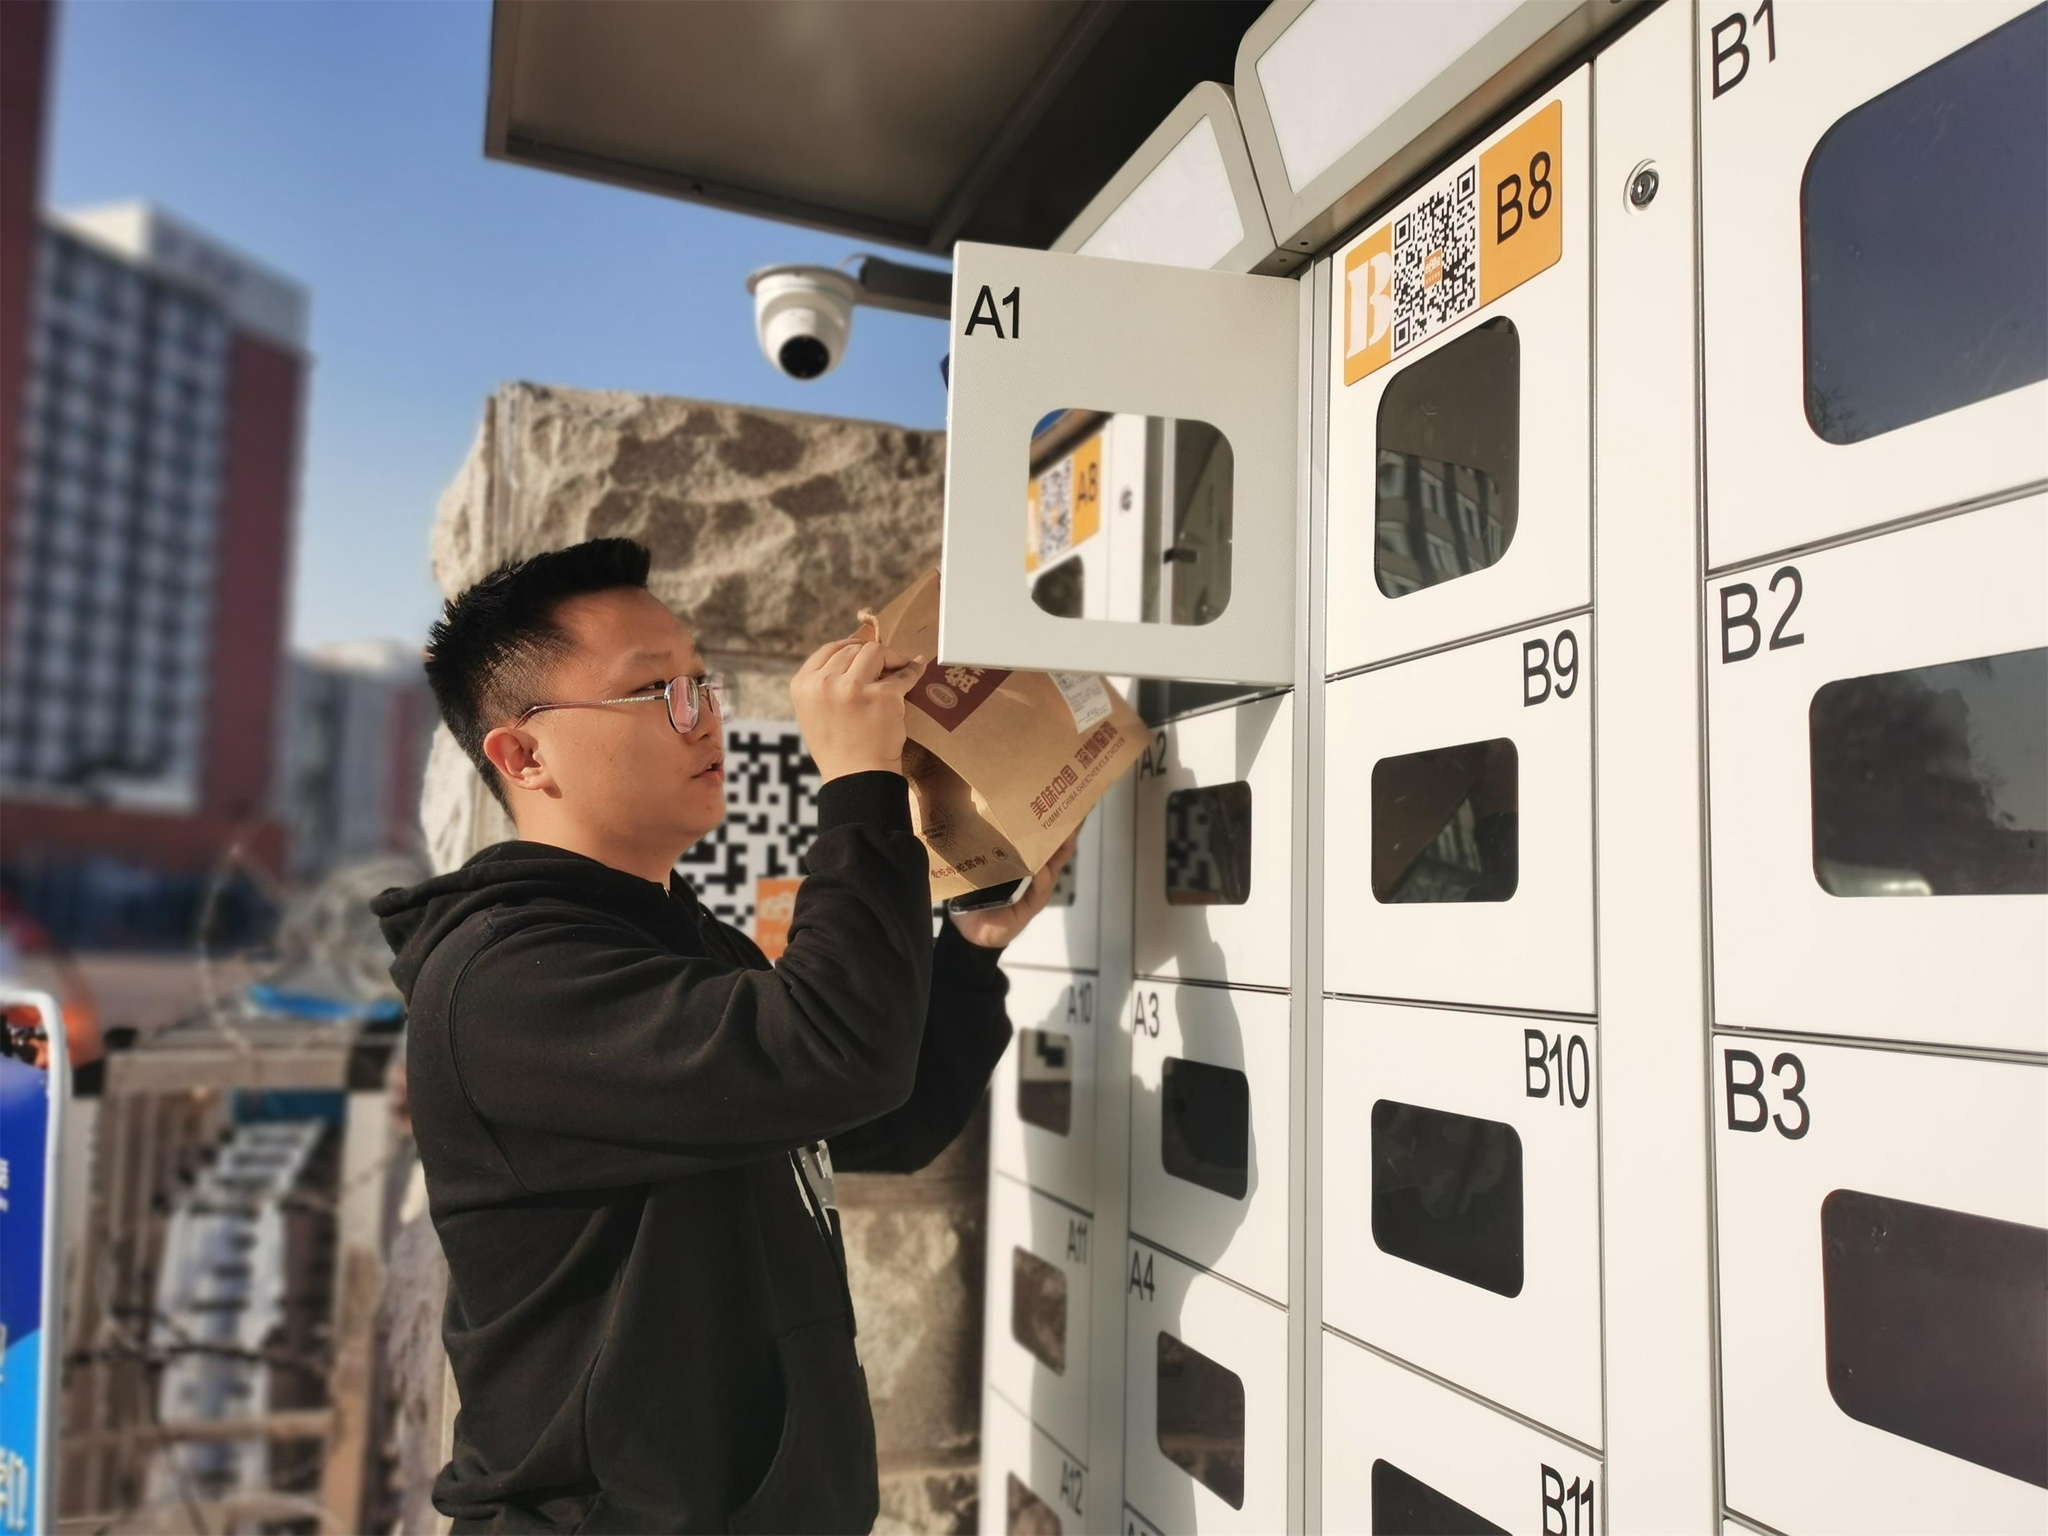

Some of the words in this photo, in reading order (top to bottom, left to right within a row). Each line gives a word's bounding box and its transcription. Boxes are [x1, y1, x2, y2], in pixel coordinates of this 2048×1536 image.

[1711, 0, 1776, 100] B1
[1497, 151, 1552, 245] B8
[963, 284, 1021, 340] A1
[1720, 566, 1806, 664] B2
[1522, 630, 1580, 707] B9
[1140, 730, 1167, 781] A2
[1030, 764, 1079, 820] 美味中国
[1041, 805, 1063, 830] YUMMY
[1062, 790, 1079, 810] CHINA
[1076, 764, 1101, 795] SHENZHEN
[1066, 985, 1093, 1026] A10
[1133, 991, 1160, 1038] A3
[1524, 1029, 1590, 1109] B10
[1724, 1050, 1811, 1140] B3
[1066, 1218, 1088, 1265] A11
[1128, 1250, 1156, 1302] A4
[1059, 1459, 1083, 1517] A12
[1541, 1463, 1595, 1536] B11
